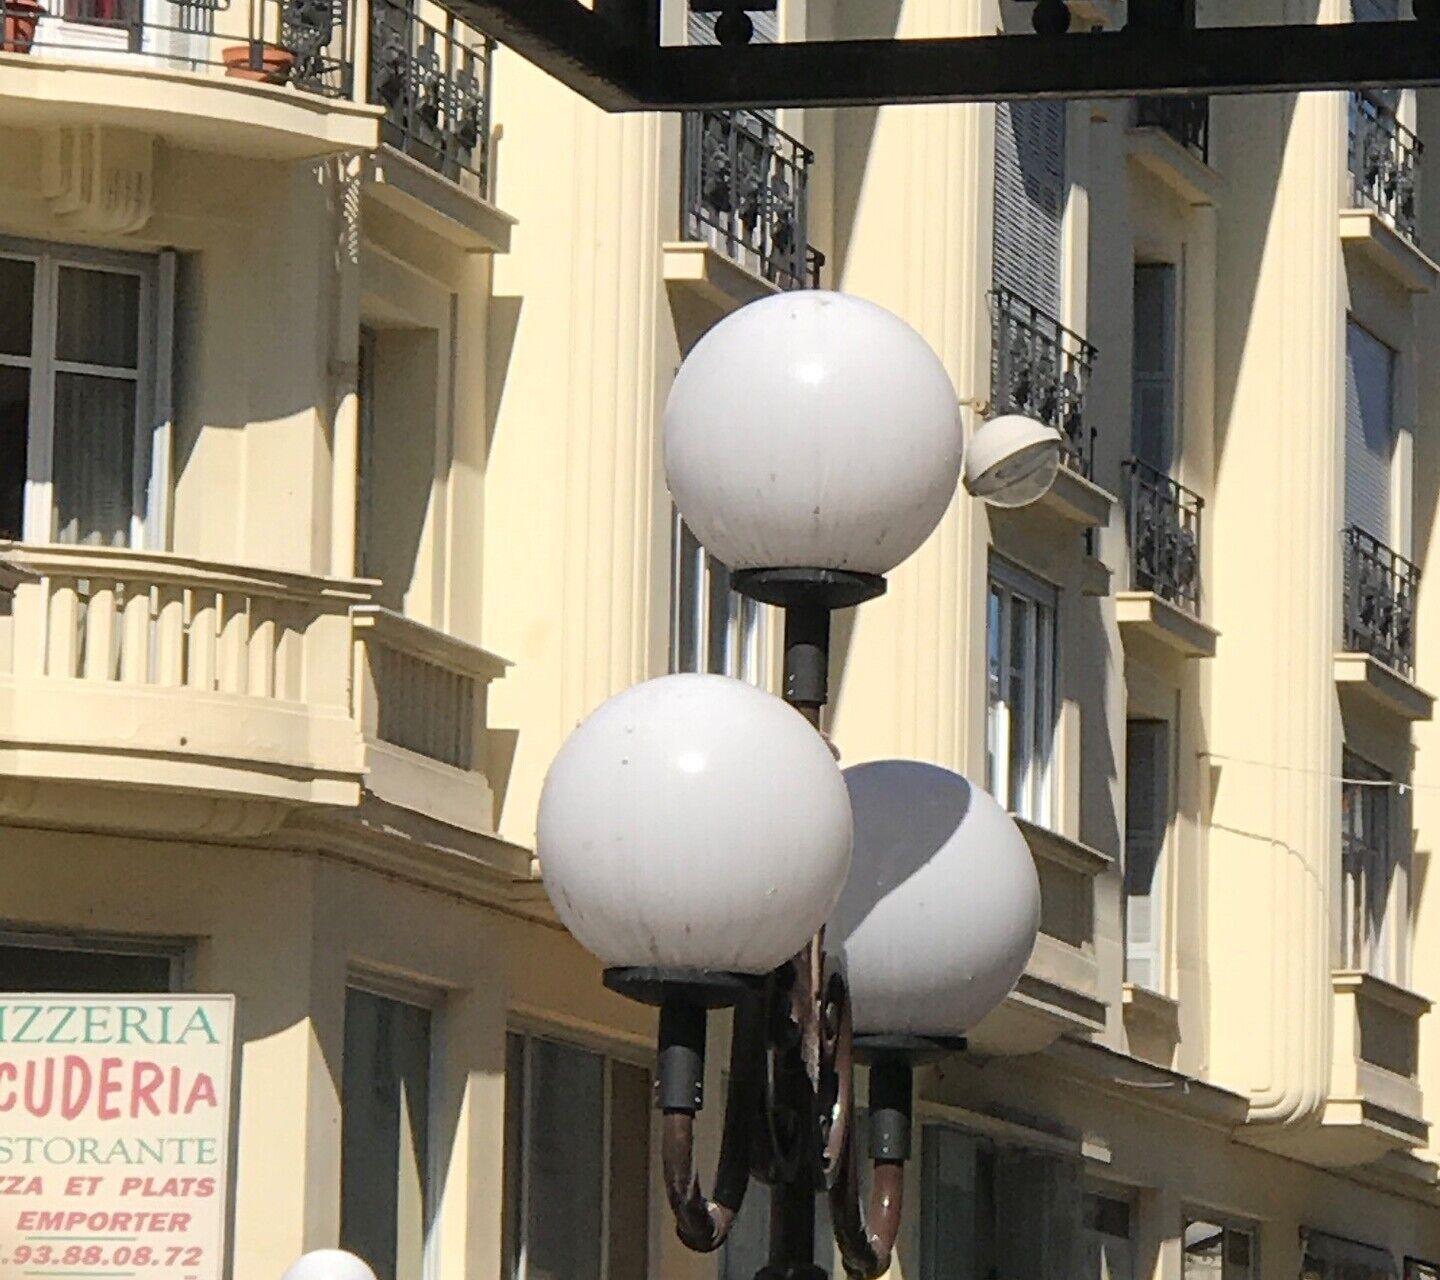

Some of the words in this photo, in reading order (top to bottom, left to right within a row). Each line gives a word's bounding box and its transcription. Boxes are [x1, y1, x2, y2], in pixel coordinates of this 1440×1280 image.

[64, 1177, 104, 1196] ET
[119, 1177, 216, 1198] PLATS
[16, 1211, 193, 1232] EMPORTER
